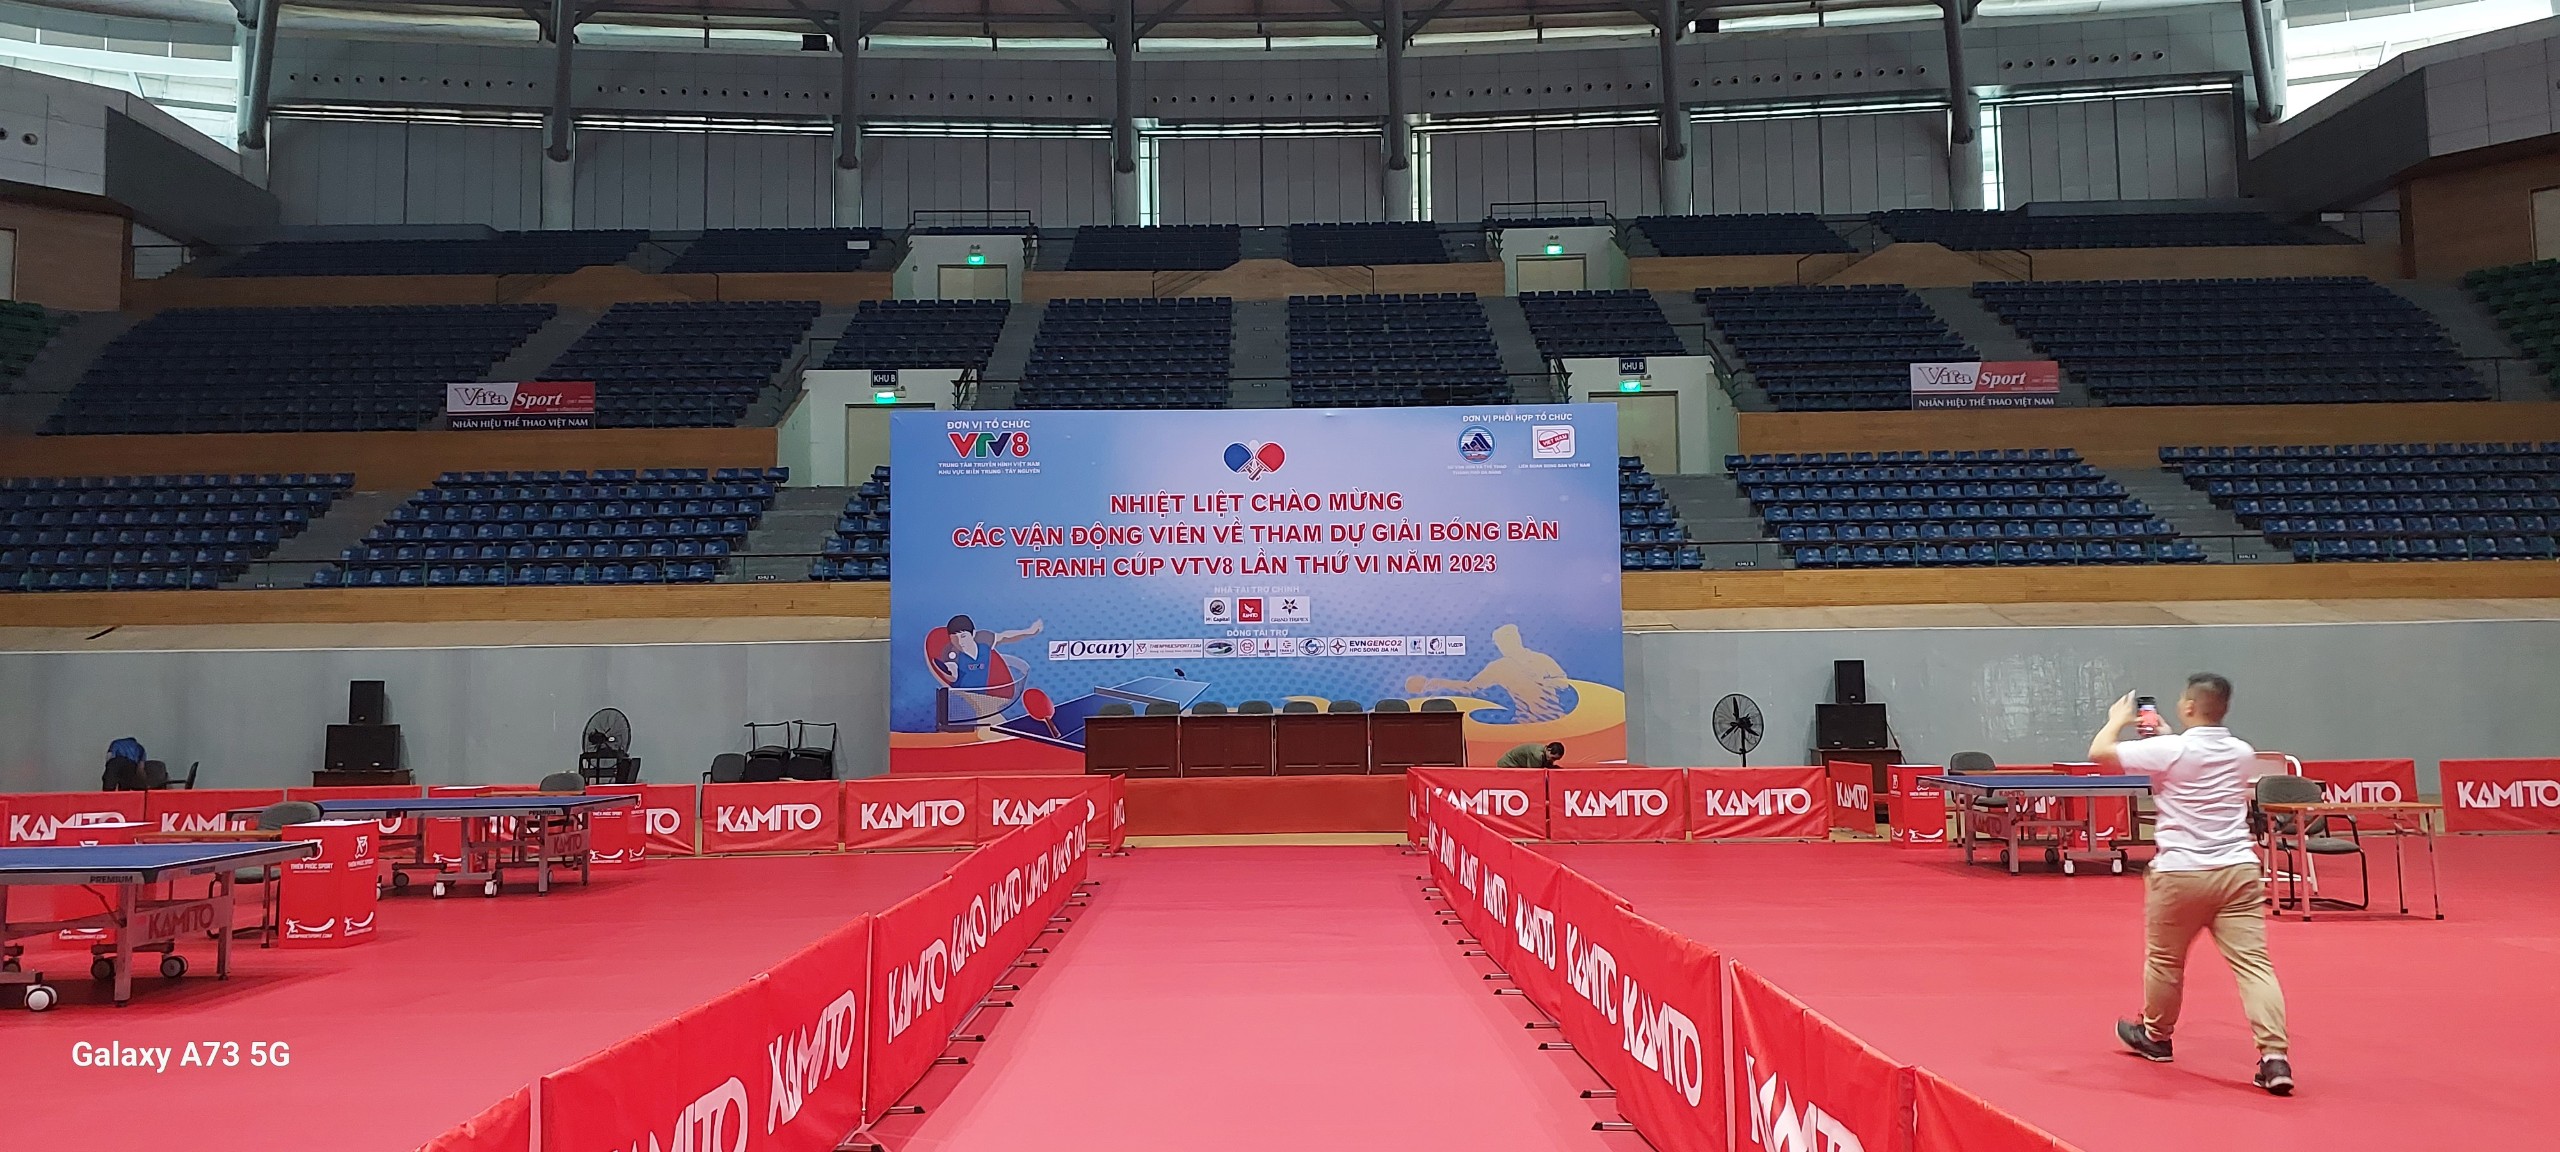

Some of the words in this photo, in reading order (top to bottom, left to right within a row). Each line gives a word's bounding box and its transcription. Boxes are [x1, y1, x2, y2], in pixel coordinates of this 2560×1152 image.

[873, 374, 890, 382] KHU
[891, 374, 896, 382] B
[1622, 362, 1638, 370] KHU
[1639, 362, 1644, 370] B
[1918, 366, 1973, 385] Vifa
[1978, 371, 2027, 389] Sport
[454, 387, 509, 406] Vifa
[514, 392, 563, 410] Sport
[1946, 397, 1967, 409] HIỆU
[1969, 395, 1986, 406] THỂ
[1987, 398, 2012, 406] THAO
[2013, 397, 2032, 408] VIỆT
[2034, 398, 2054, 406] NAM
[480, 417, 501, 430] HIỆU
[503, 416, 520, 427] THỂ
[522, 419, 546, 427] THAO
[547, 417, 566, 429] VIỆT
[568, 418, 588, 427] NAM
[947, 420, 970, 430] ĐƠN
[972, 421, 982, 431] VỊ
[1001, 419, 1031, 428] CHỨC
[1462, 414, 1480, 422] ĐƠN
[1482, 414, 1491, 423] VỊ
[948, 431, 1030, 459] VTV8
[1110, 489, 1186, 517] NHIỆT
[1193, 489, 1245, 517] LIỆT
[1250, 488, 1322, 512] CHÀO
[1328, 487, 1403, 512] MỪNG
[952, 522, 1006, 548] CÁC
[1009, 522, 1064, 551] VẬN
[1070, 521, 1144, 550] ĐỘNG
[1148, 521, 1206, 545] VIÊN
[1212, 516, 1245, 544] VỀ
[1249, 524, 1323, 543] THAM
[1329, 521, 1367, 547] DỰ
[1370, 518, 1422, 542] GIẢI
[1429, 516, 1500, 542] BÓNG
[1506, 516, 1559, 541] BÀN
[1016, 557, 1106, 579] TRANH
[1112, 552, 1166, 577] CÚP
[1170, 556, 1234, 575] VTV8
[1240, 548, 1288, 576] LẦN
[1294, 550, 1349, 575] THỨ
[1353, 555, 1380, 574] VI
[1386, 550, 1443, 574] NĂM
[1448, 553, 1497, 574] 2023
[1270, 628, 1289, 637] TRỢ
[1070, 640, 1133, 659] Ocany
[1564, 788, 1669, 817] KAMITO
[1706, 787, 1812, 816] KAMITO
[1836, 781, 1869, 811] KAMITO
[2321, 780, 2402, 803] AMITO
[2456, 780, 2560, 808] KAMITO
[717, 803, 822, 832] KAMITO
[860, 799, 966, 830] KAMITO
[89, 875, 134, 884] PREMIUM
[149, 903, 215, 940] KAMITO
[888, 938, 948, 1045] KAMITO
[1622, 974, 1703, 1107] KAMITO
